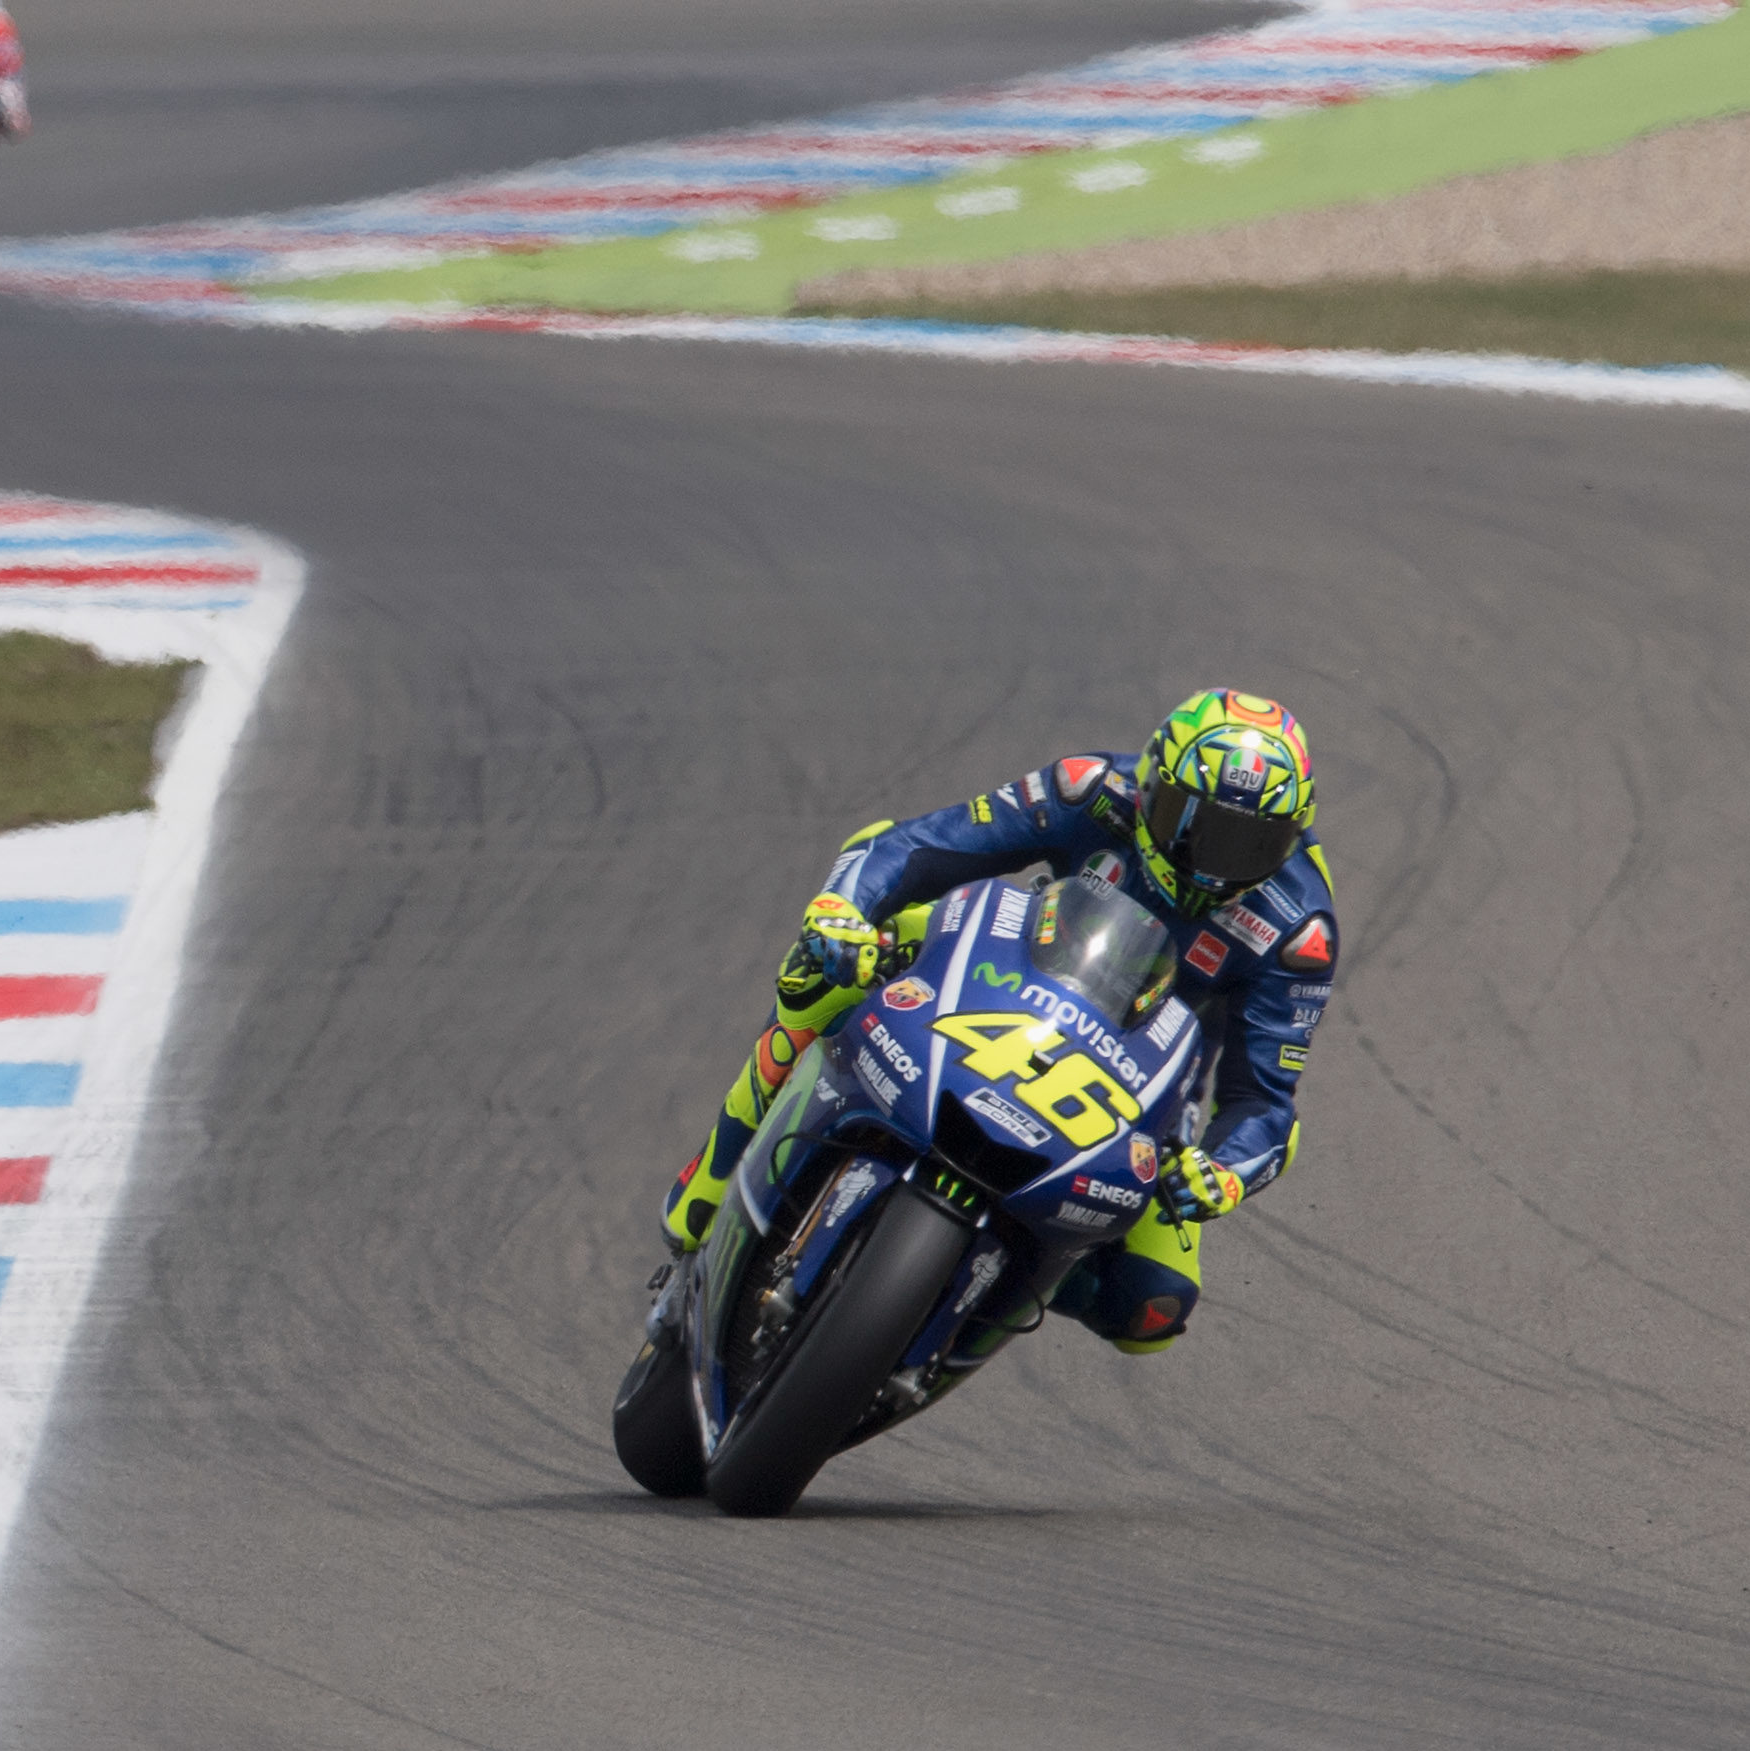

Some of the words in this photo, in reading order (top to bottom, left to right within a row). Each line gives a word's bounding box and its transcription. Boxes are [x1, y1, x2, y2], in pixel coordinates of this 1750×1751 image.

[990, 887, 1031, 939] YAMAHA
[868, 1024, 923, 1083] ENEOS
[1020, 984, 1148, 1089] movistar
[927, 1011, 1143, 1150] 46
[1087, 1179, 1144, 1209] ENEOS
